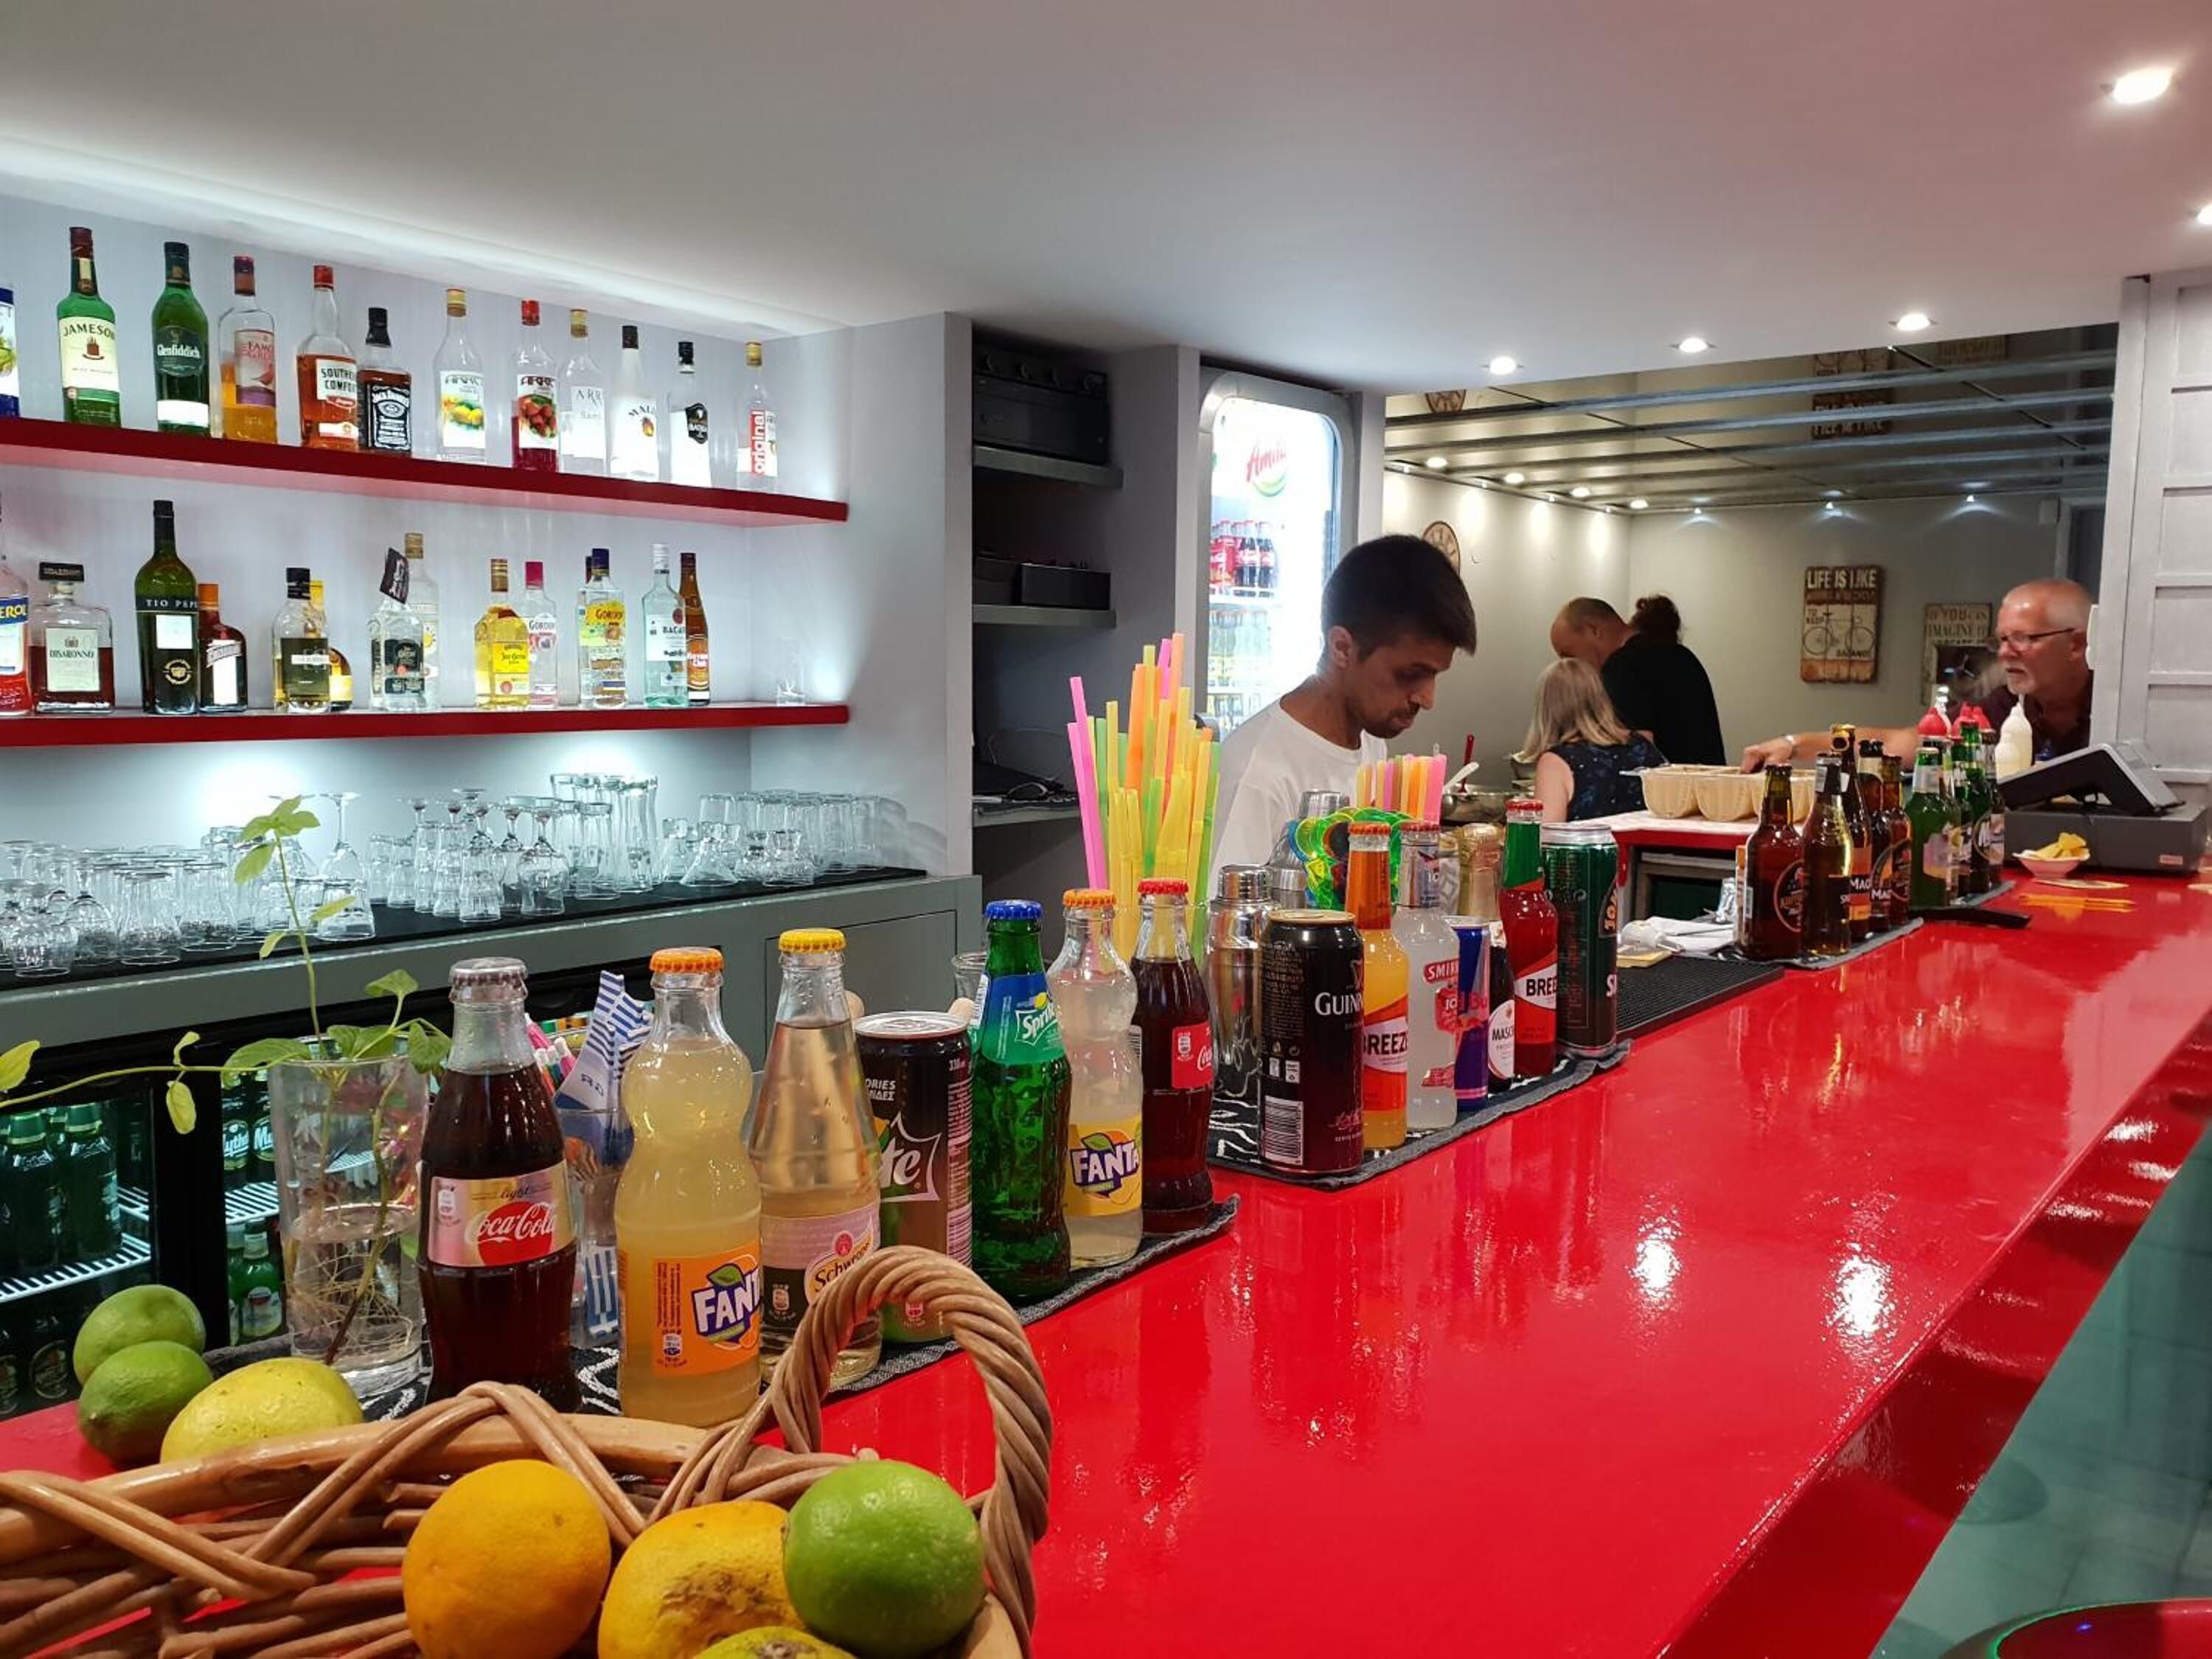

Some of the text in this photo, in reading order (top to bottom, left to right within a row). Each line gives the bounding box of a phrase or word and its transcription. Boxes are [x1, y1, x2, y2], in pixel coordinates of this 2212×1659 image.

[1806, 568, 1877, 589] LIFE IS LIKE
[146, 599, 169, 608] TIO
